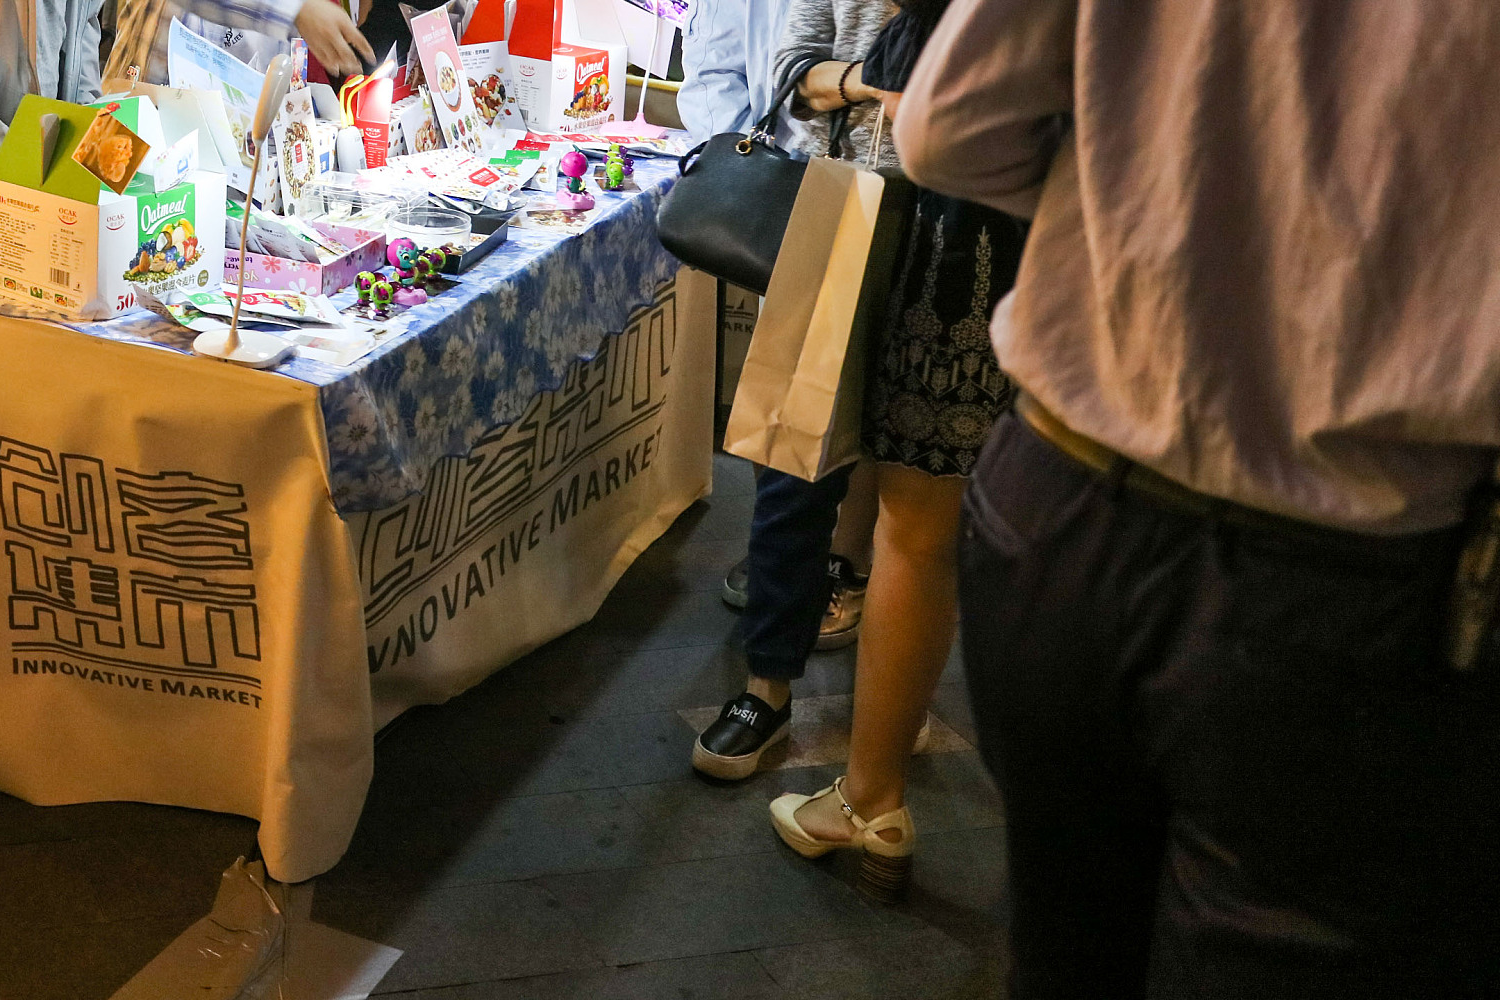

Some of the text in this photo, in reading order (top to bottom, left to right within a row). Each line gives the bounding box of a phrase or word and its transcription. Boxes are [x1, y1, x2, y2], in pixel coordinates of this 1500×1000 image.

[576, 57, 606, 83] Oatmeal
[106, 213, 125, 223] OCAK
[141, 195, 187, 232] Oatmeal
[550, 425, 664, 534] MARKET
[12, 657, 262, 709] INNOVATIVE MARKET
[727, 704, 758, 726] PUSH
